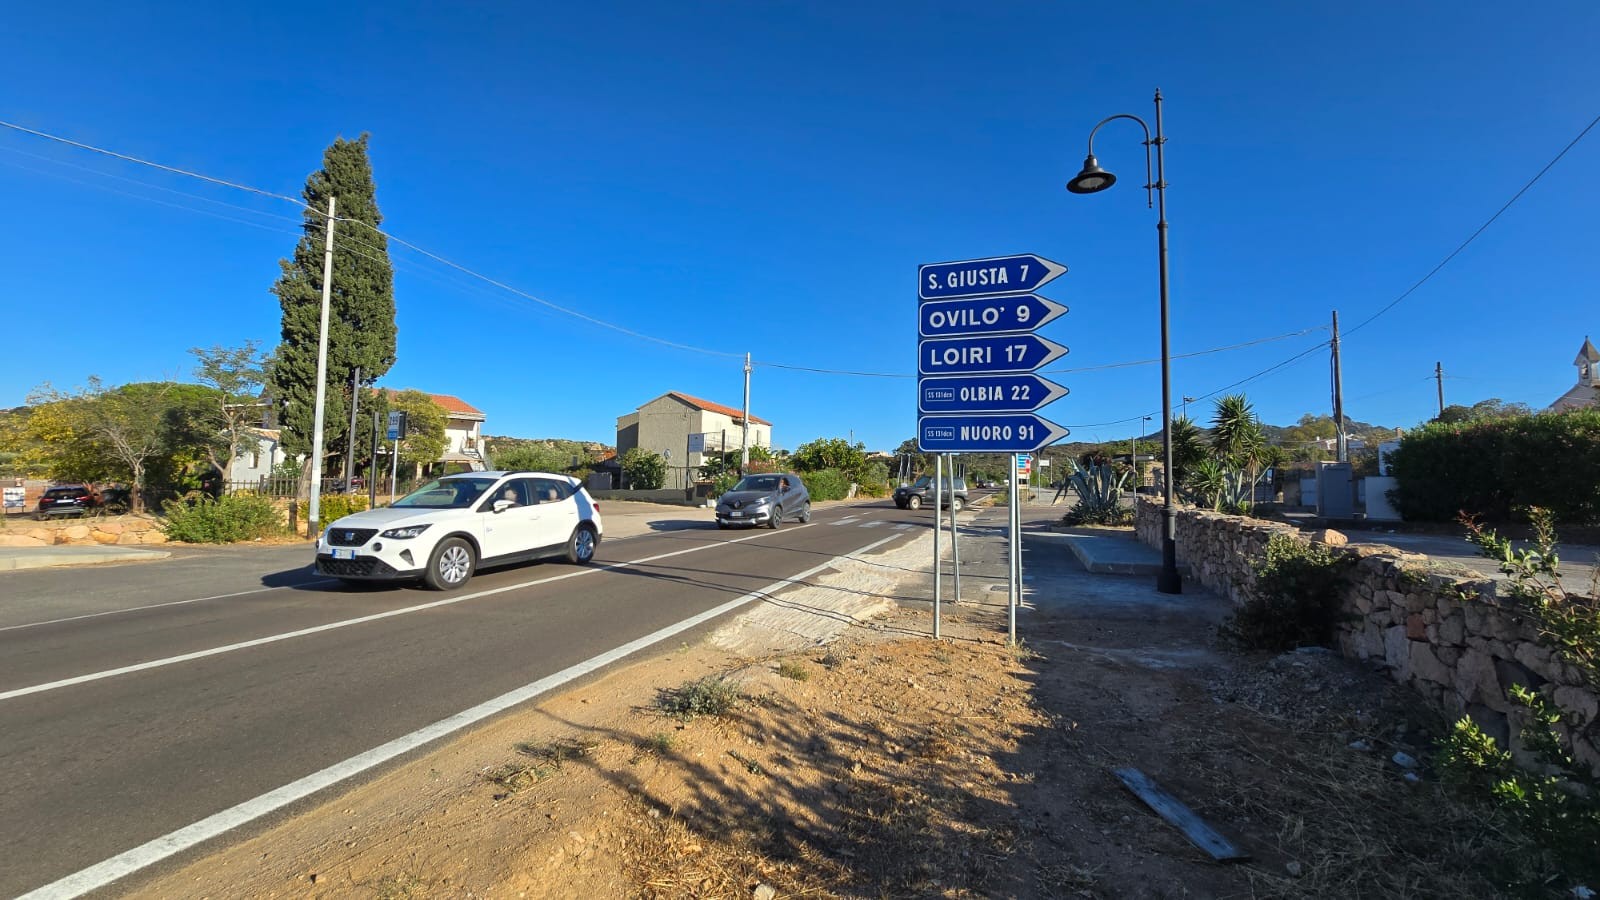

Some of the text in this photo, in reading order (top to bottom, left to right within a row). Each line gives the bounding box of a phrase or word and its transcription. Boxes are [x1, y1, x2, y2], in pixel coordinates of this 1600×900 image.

[928, 264, 1029, 290] S. GIUSTA 7
[929, 305, 1031, 328] OVILO' 9
[931, 344, 1028, 366] LOIRI 17
[960, 384, 1030, 401] OLBIA 22
[960, 424, 1034, 441] NUORO 91
